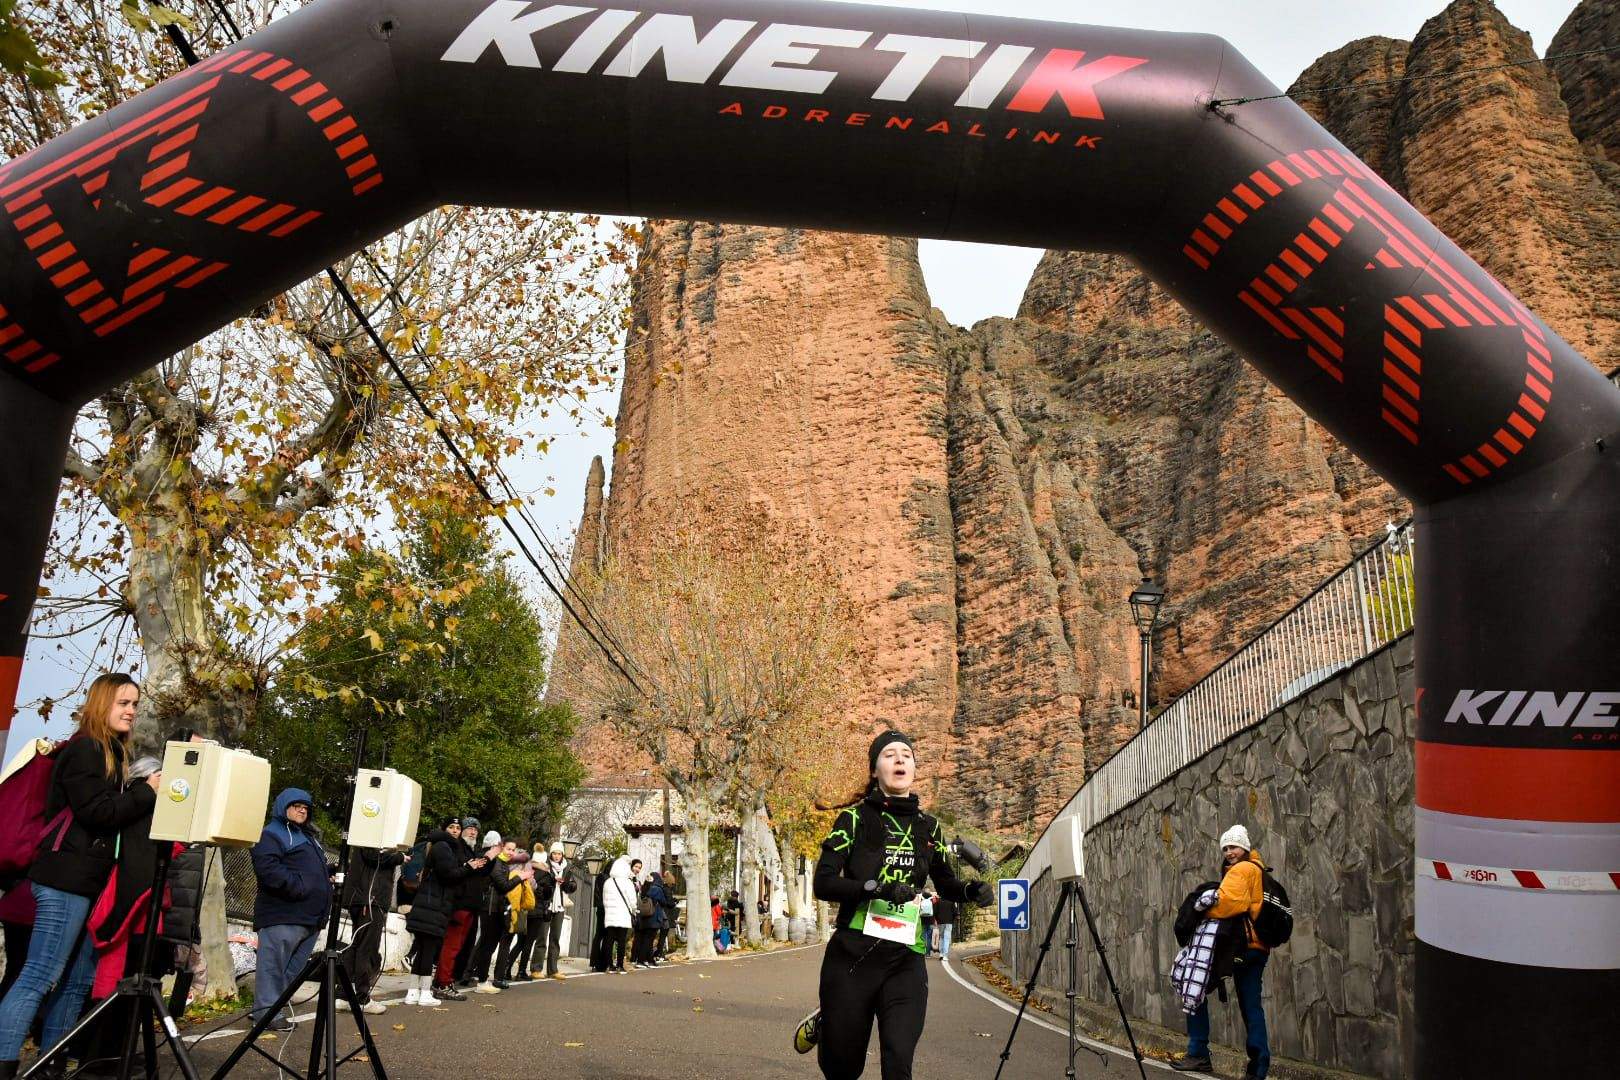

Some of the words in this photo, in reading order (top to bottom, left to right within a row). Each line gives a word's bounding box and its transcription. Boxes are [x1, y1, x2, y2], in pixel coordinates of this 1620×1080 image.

[439, 0, 1149, 120] KINETIK
[718, 102, 1104, 149] ADRENALINK
[1443, 689, 1620, 728] KINE
[1000, 883, 1026, 920] P
[1014, 911, 1027, 928] 4
